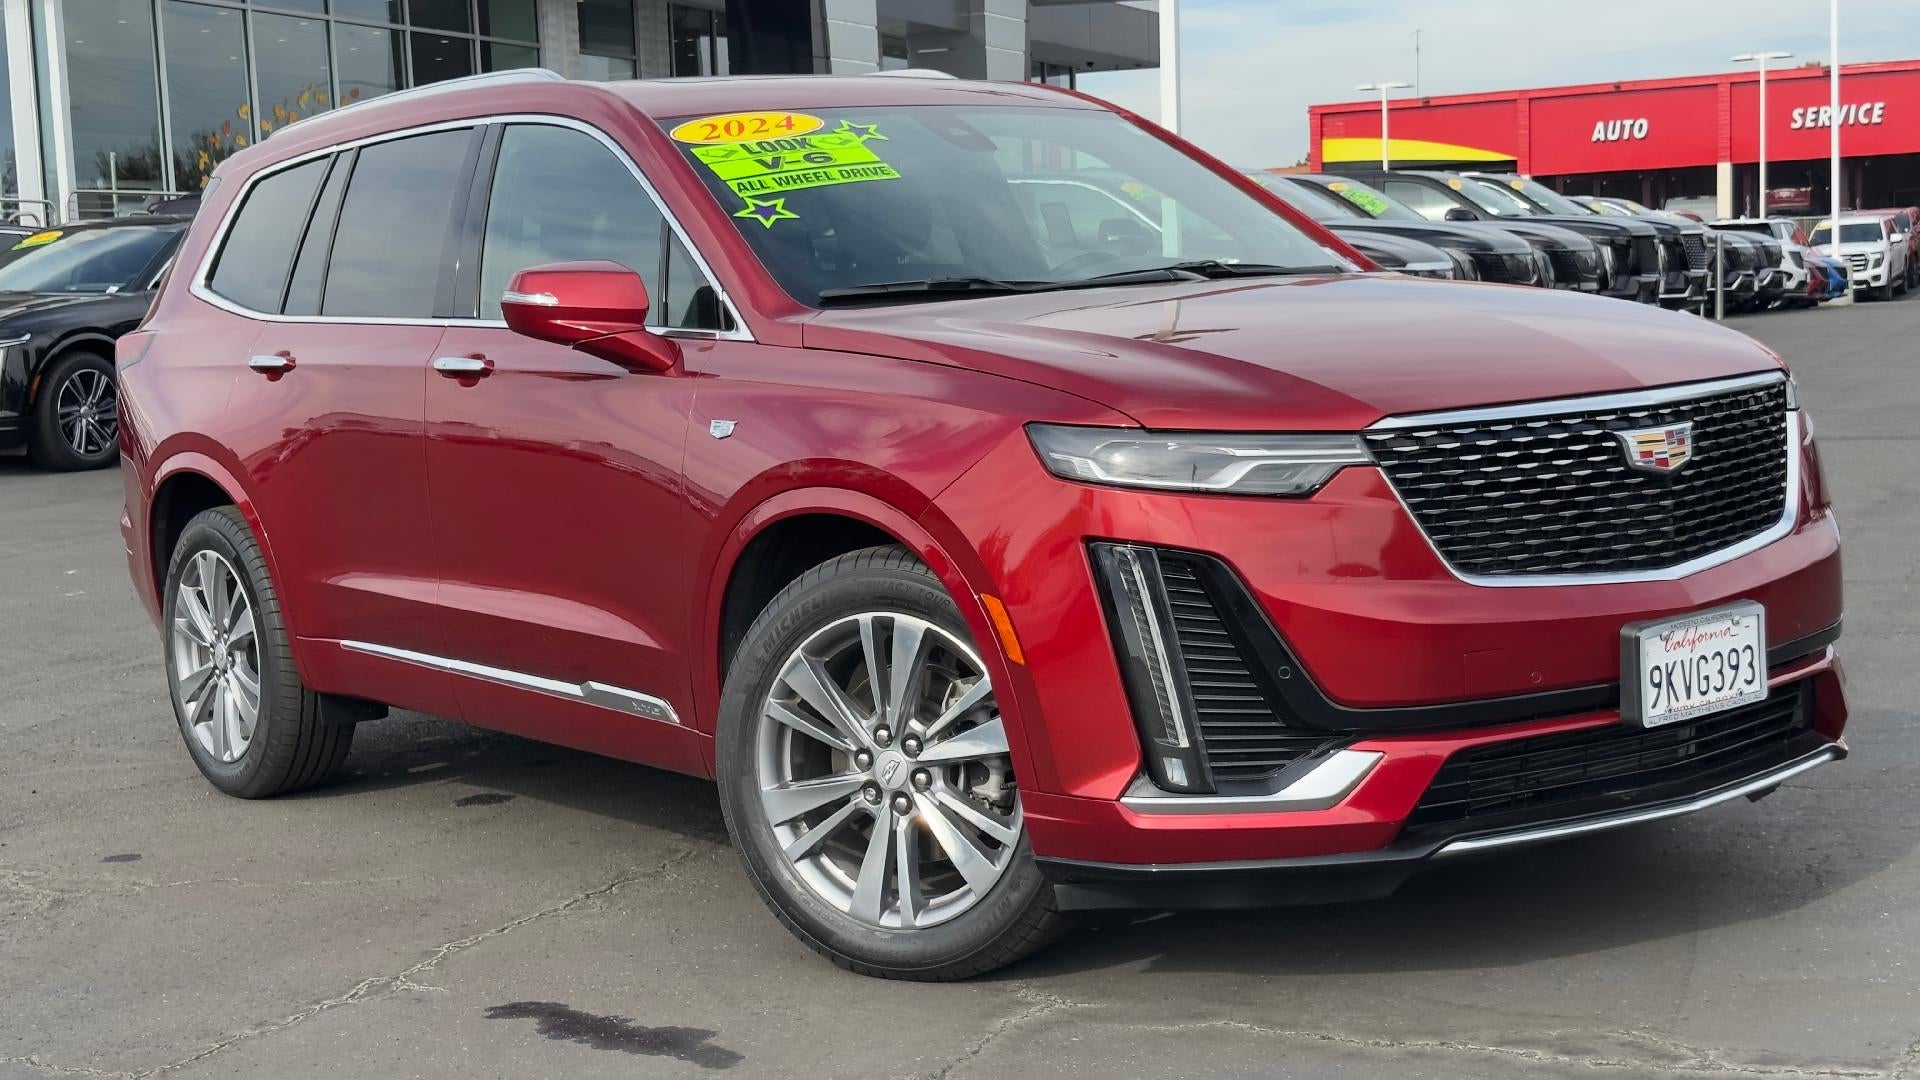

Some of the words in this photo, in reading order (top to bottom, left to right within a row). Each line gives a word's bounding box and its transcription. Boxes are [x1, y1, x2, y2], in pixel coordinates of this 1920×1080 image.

[700, 115, 796, 141] 2024
[1790, 102, 1886, 129] SERVICE
[1591, 118, 1649, 142] AUTO
[741, 138, 819, 156] LOOK
[755, 151, 834, 171] V-6
[736, 180, 770, 194] ALL
[775, 170, 836, 189] WHEEL
[838, 165, 892, 181] DRIVE
[918, 587, 952, 609] TOUR
[1665, 626, 1738, 653] California
[1650, 643, 1756, 710] 9KVG393
[1680, 702, 1725, 718] MATTHEWS
[1726, 693, 1765, 707] CADILAC
